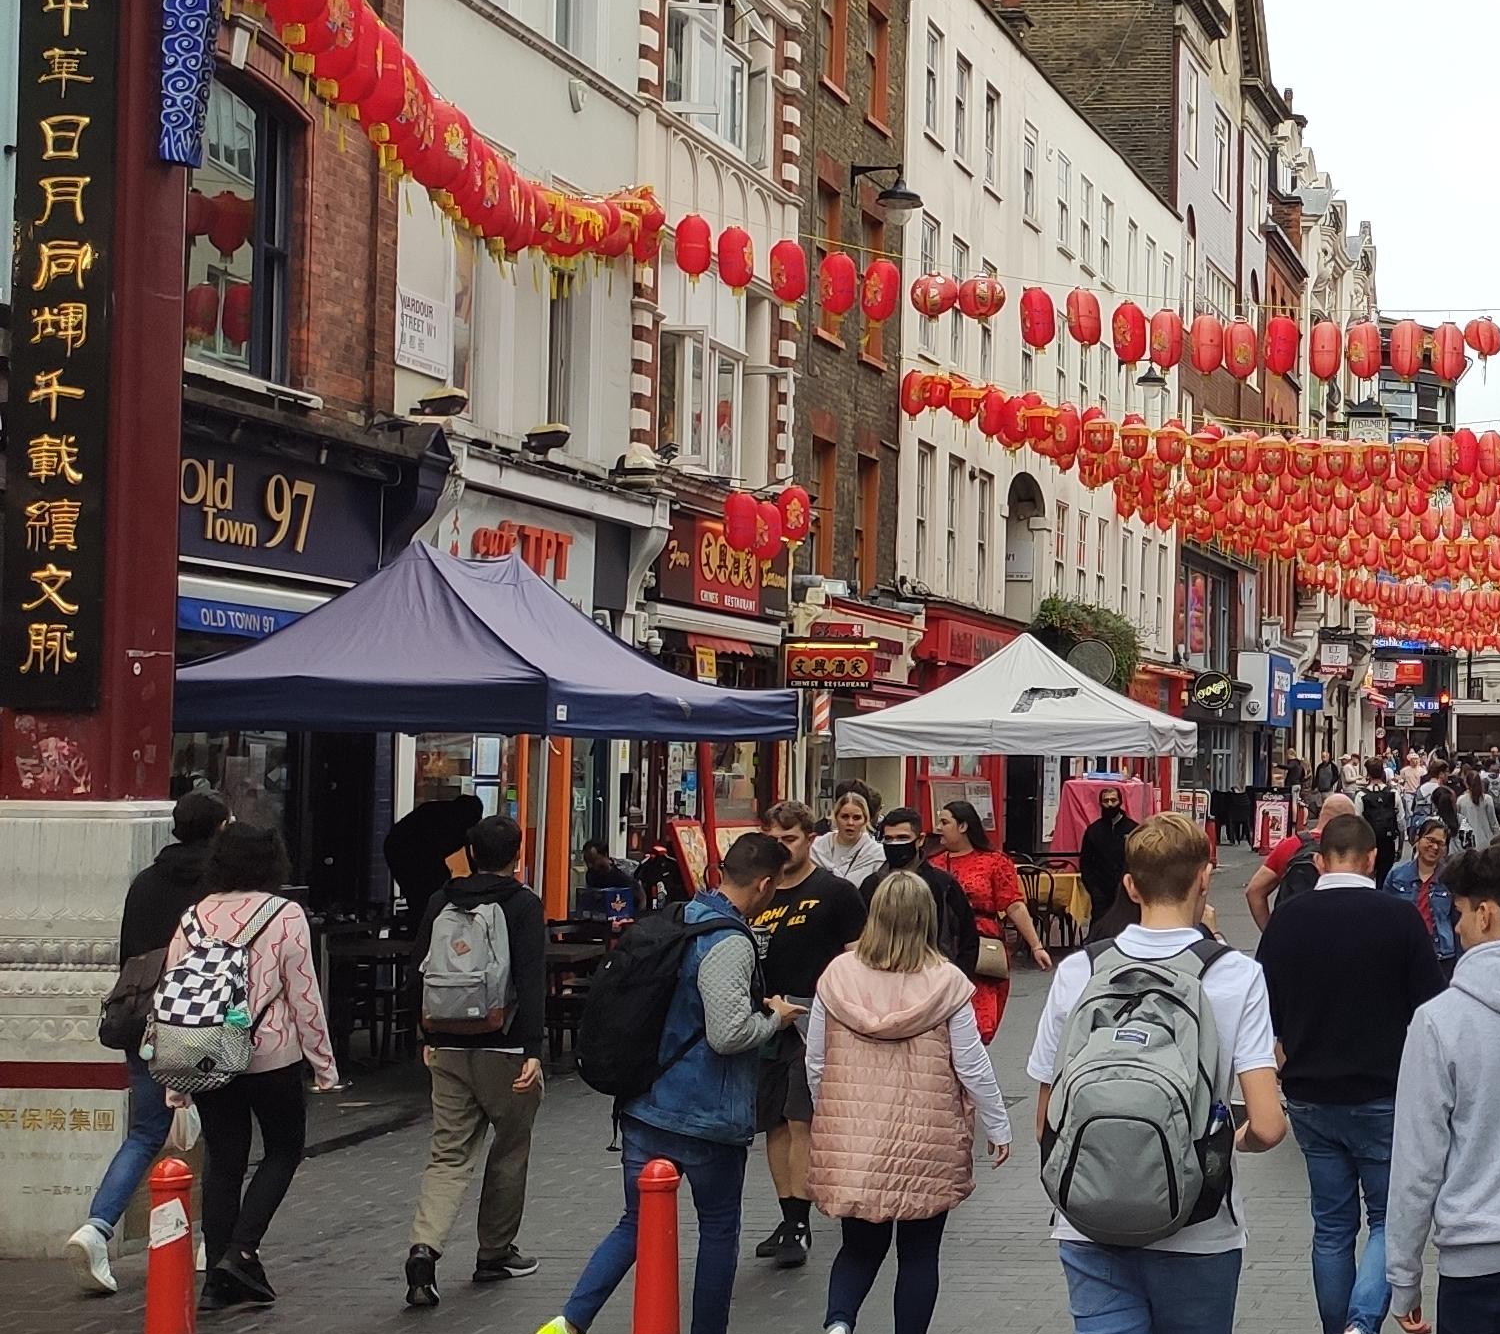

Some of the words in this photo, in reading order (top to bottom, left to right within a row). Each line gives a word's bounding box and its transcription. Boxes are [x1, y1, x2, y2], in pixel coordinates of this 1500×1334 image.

[400, 293, 434, 320] WARDOUR
[400, 313, 425, 335] STREET
[426, 322, 437, 340] W1
[181, 458, 234, 511] Old
[264, 473, 316, 554] 97
[202, 505, 257, 548] Town
[520, 524, 575, 581] TPT
[200, 607, 226, 627] OLD
[227, 611, 260, 631] TOWN
[262, 615, 275, 633] 97
[793, 658, 864, 675] 文興酒家
[790, 680, 819, 688] CHINESE
[823, 680, 870, 689] RESTAURANT
